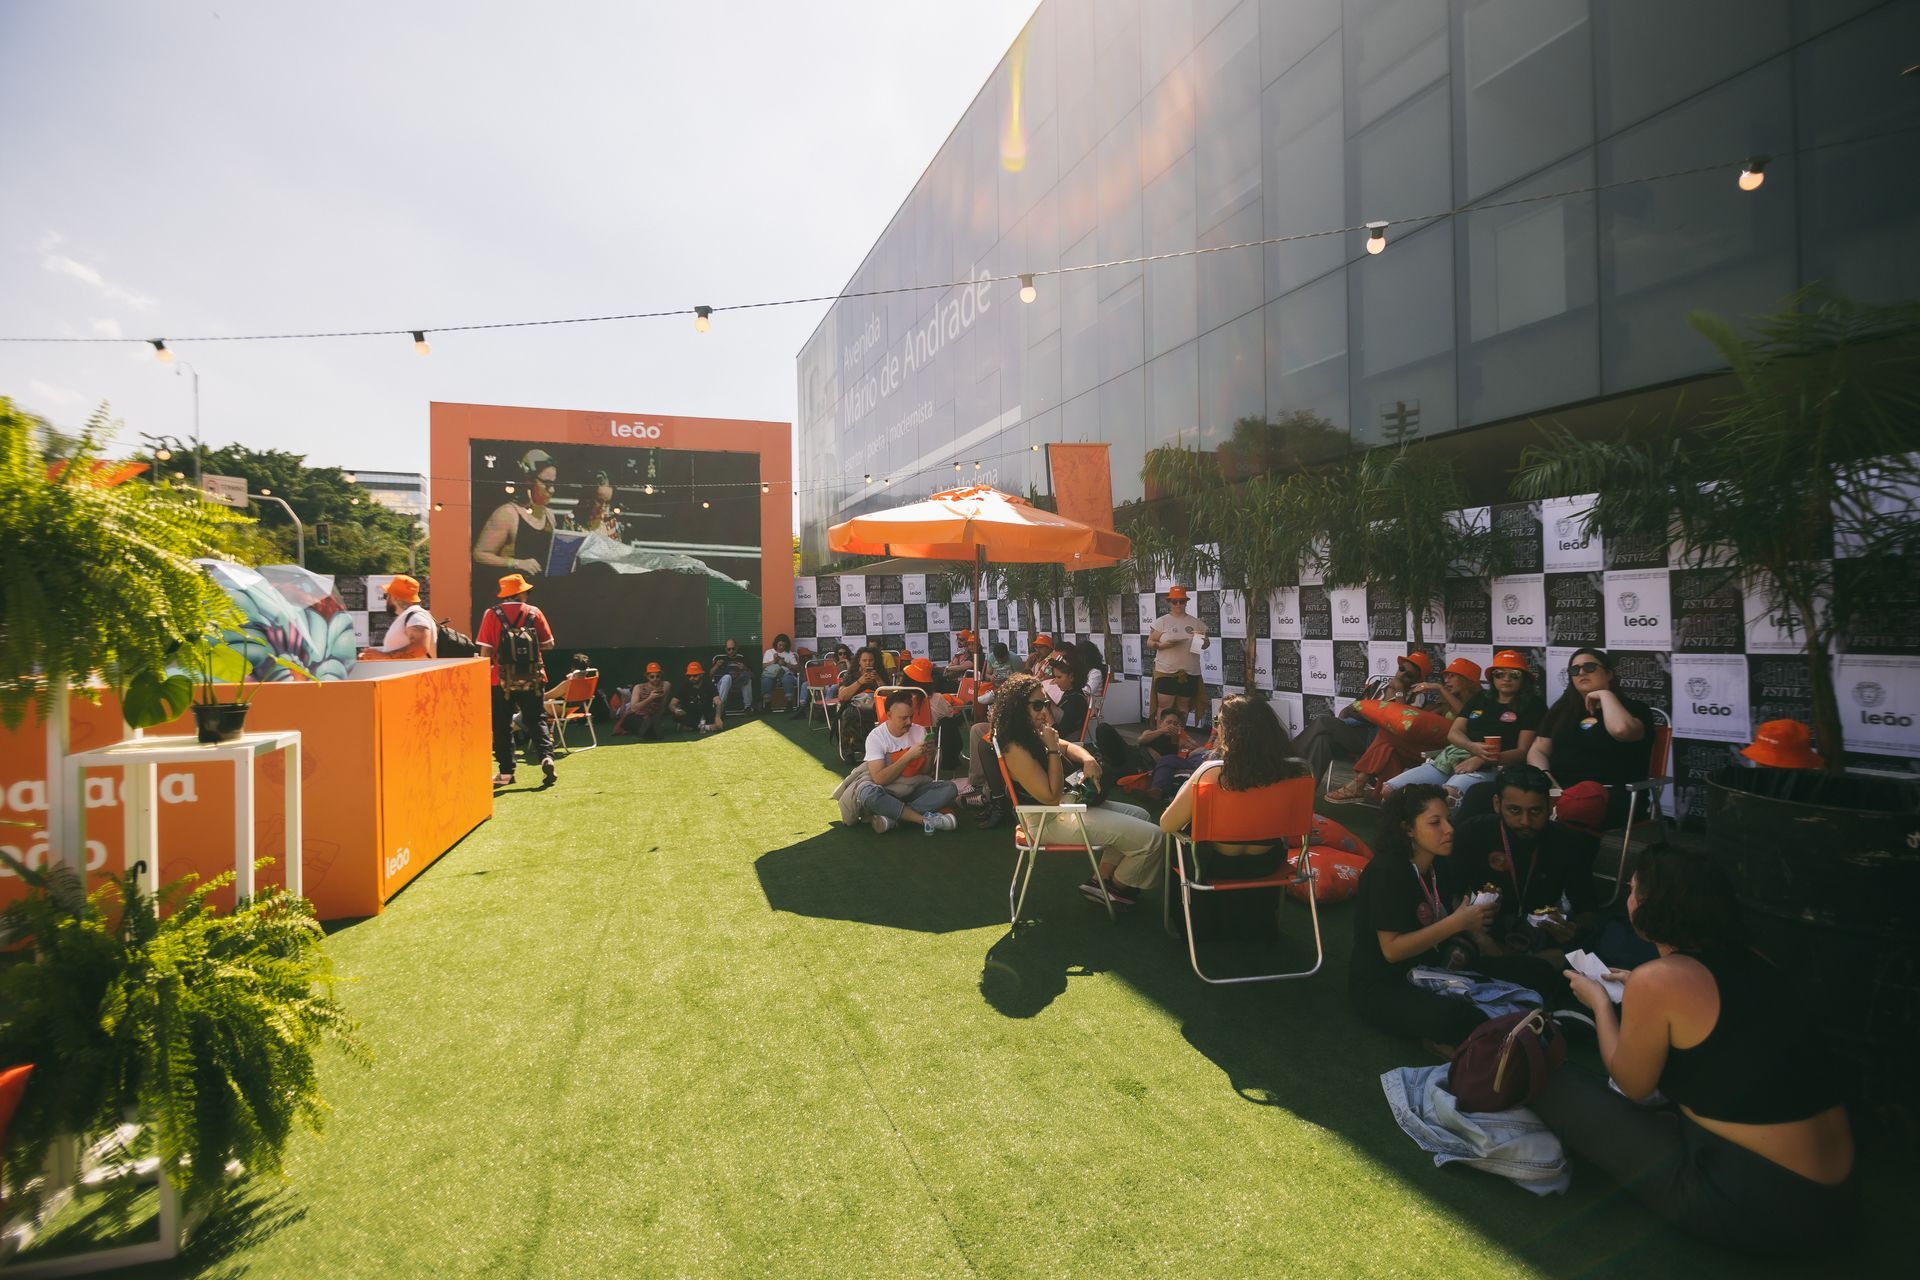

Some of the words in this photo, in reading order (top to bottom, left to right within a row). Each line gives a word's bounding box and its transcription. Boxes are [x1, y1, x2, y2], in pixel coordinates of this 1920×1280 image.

[844, 312, 880, 374] Avenida
[844, 372, 877, 430] Mário
[881, 352, 898, 398] de
[903, 264, 991, 380] Andrade
[611, 420, 661, 439] leão
[889, 400, 933, 443] modernista
[1278, 615, 1294, 625] leão
[1342, 615, 1361, 625] leão
[1507, 614, 1534, 626] leão
[1624, 615, 1659, 628] leão
[1205, 663, 1218, 672] leão
[1310, 670, 1328, 681] leão
[1692, 702, 1733, 718] leão
[1860, 709, 1914, 729] leão
[385, 847, 410, 879] leão
